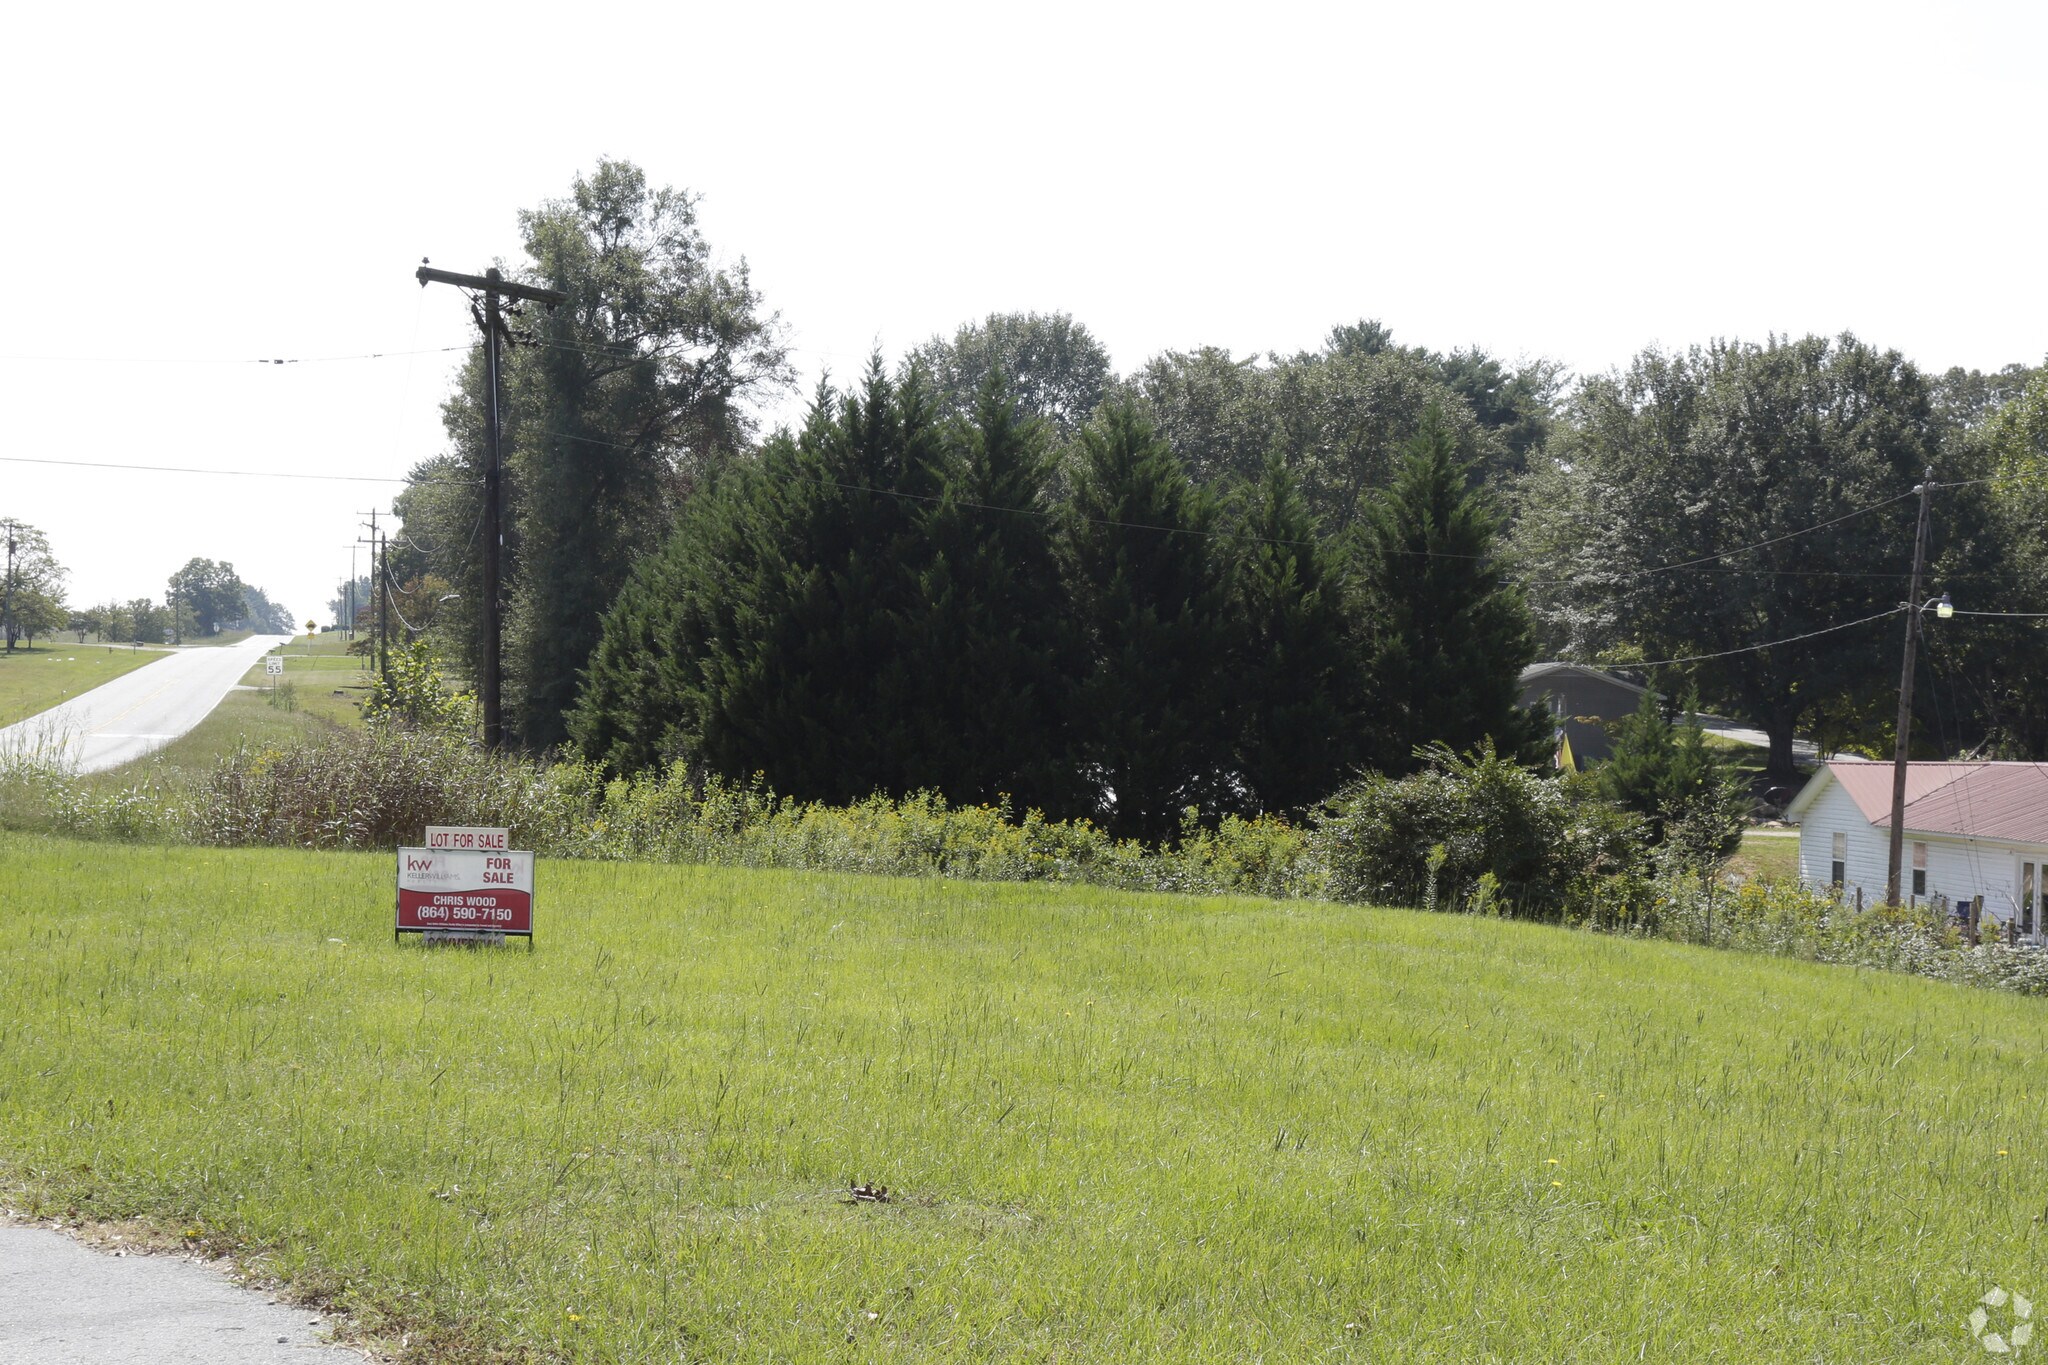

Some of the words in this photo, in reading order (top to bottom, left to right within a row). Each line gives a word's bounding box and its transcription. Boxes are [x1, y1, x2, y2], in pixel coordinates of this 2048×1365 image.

[430, 833, 449, 847] LOT
[453, 834, 474, 848] FOR
[478, 834, 504, 849] SALE
[486, 858, 511, 870] FOR
[483, 872, 514, 884] SALE
[433, 895, 464, 906] CHRIS
[466, 897, 496, 907] WOOD
[417, 906, 449, 921] (864)
[453, 907, 512, 921] 590-7150
